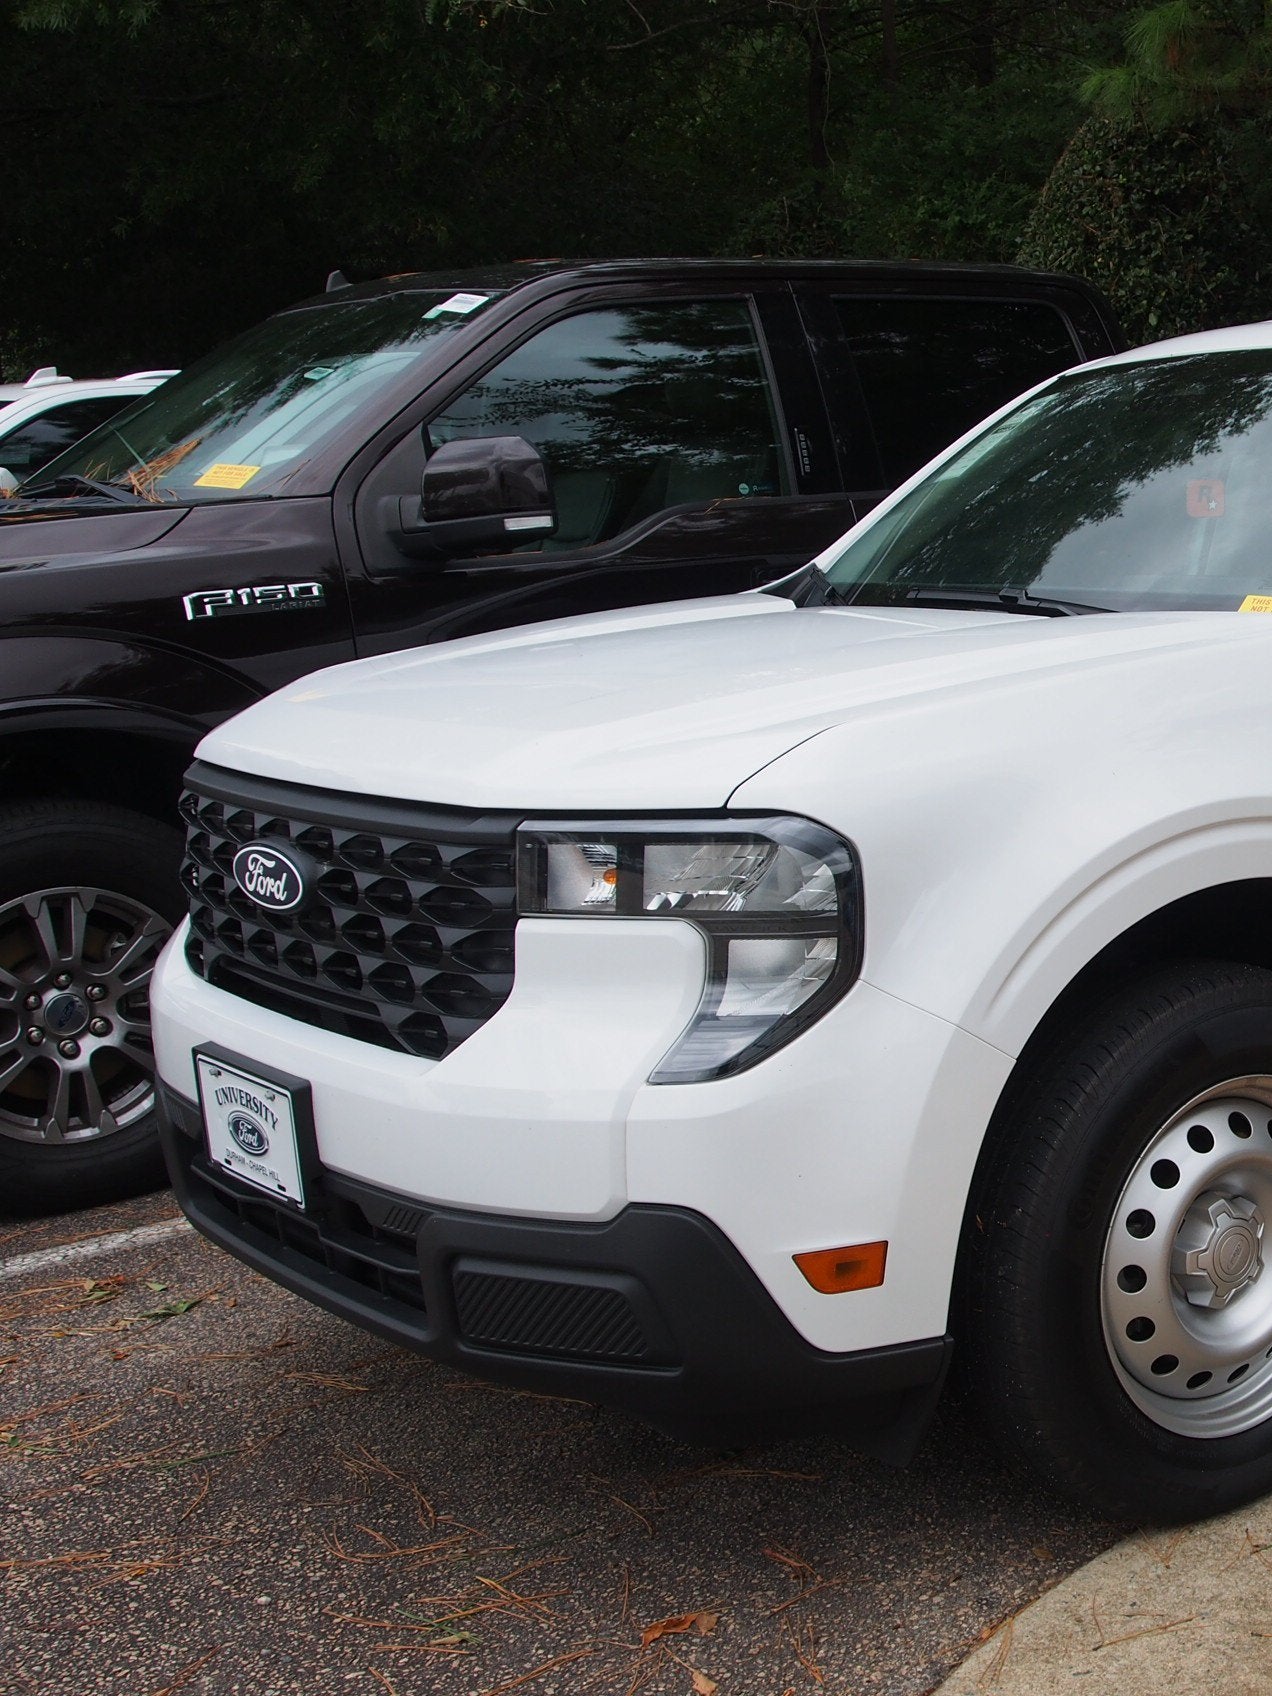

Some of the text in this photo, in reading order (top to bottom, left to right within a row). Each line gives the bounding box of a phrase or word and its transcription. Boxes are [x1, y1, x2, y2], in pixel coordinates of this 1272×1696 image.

[271, 599, 321, 611] LARIAT
[1251, 598, 1271, 606] THIS
[245, 853, 287, 901] Ford
[214, 1087, 278, 1130] UNIVERSITY
[238, 1121, 259, 1147] Ford
[225, 1148, 246, 1164] DURHAM
[249, 1160, 268, 1176] CHAPEL
[269, 1169, 280, 1181] HILL
